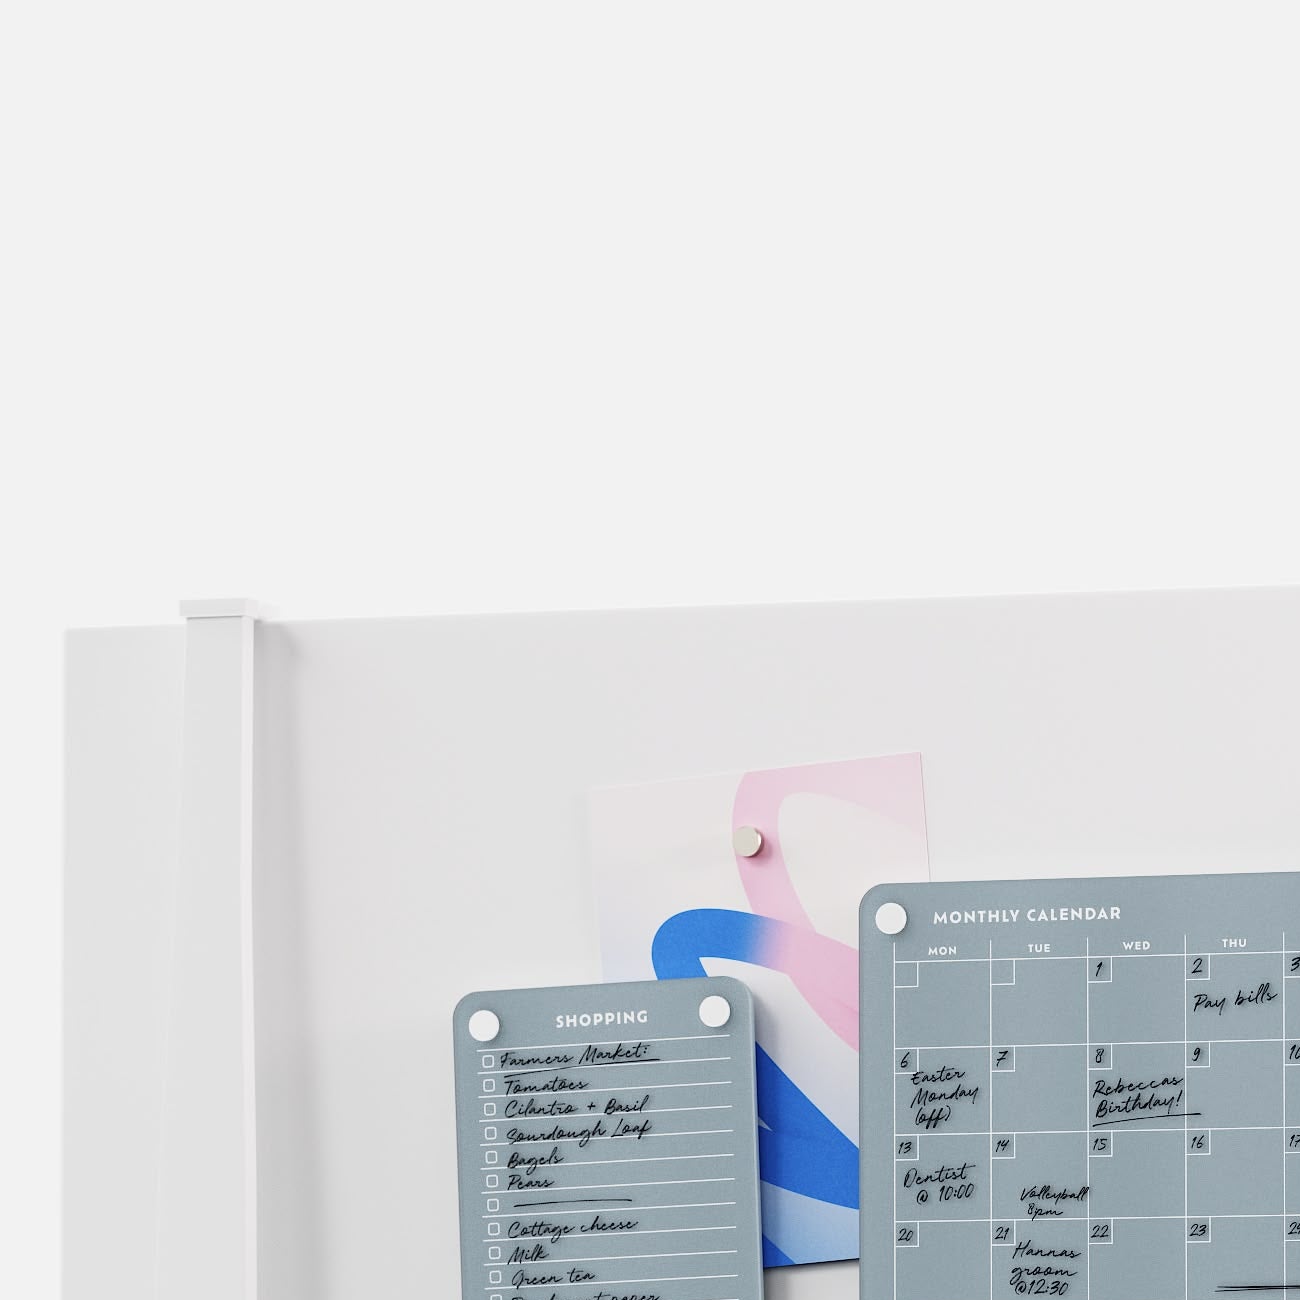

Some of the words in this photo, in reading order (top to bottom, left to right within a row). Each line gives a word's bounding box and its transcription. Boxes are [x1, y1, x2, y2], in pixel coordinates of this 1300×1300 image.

[933, 909, 1020, 925] MONTHLY
[1027, 907, 1121, 922] CALENDAR
[928, 946, 957, 956] MON
[1028, 944, 1050, 953] TUE
[1122, 941, 1150, 950] WED
[1222, 938, 1247, 948] THU
[1095, 962, 1102, 977] 1
[1191, 959, 1203, 973] 2
[1291, 957, 1300, 971] 3
[1193, 994, 1226, 1015] Pay
[1234, 982, 1278, 1007] bills
[556, 1010, 648, 1028] SHOPPING
[500, 1051, 574, 1069] Farmers
[900, 1051, 909, 1068] 6
[996, 1051, 1008, 1067] 7
[1095, 1048, 1104, 1063] 8
[1193, 1047, 1201, 1062] 9
[504, 1076, 589, 1096] Tomatoes
[911, 1066, 966, 1086] Easter
[911, 1084, 979, 1110] Monday
[1093, 1076, 1184, 1098] Rebeccas
[504, 1100, 579, 1118] Cilantro
[604, 1095, 650, 1115] Basil
[1095, 1091, 1182, 1118] Birthday!
[915, 1105, 952, 1129] (off)
[507, 1120, 606, 1147] Sourdough
[611, 1118, 652, 1139] Loaf
[899, 1142, 912, 1154] 13
[996, 1139, 1010, 1153] 14
[1093, 1137, 1107, 1151] 15
[1191, 1136, 1203, 1149] 16
[507, 1147, 564, 1175] Bagels
[507, 1175, 555, 1190] Pears
[903, 1162, 976, 1188] Dentist
[916, 1189, 928, 1204] @
[939, 1183, 974, 1202] 10:00
[1020, 1186, 1090, 1202] Volleyball
[1028, 1202, 1063, 1221] 8pm
[507, 1222, 576, 1243] Cottage
[580, 1216, 639, 1232] cheese
[898, 1229, 913, 1242] 20
[996, 1227, 1010, 1240] 21
[1092, 1225, 1109, 1238] 22
[1190, 1224, 1207, 1237] 23
[507, 1243, 550, 1265] Milk
[1012, 1241, 1082, 1260] Hannas
[511, 1269, 564, 1288] Green
[569, 1268, 595, 1281] tea
[1010, 1266, 1078, 1285] groom
[1015, 1280, 1069, 1295] @12:30
